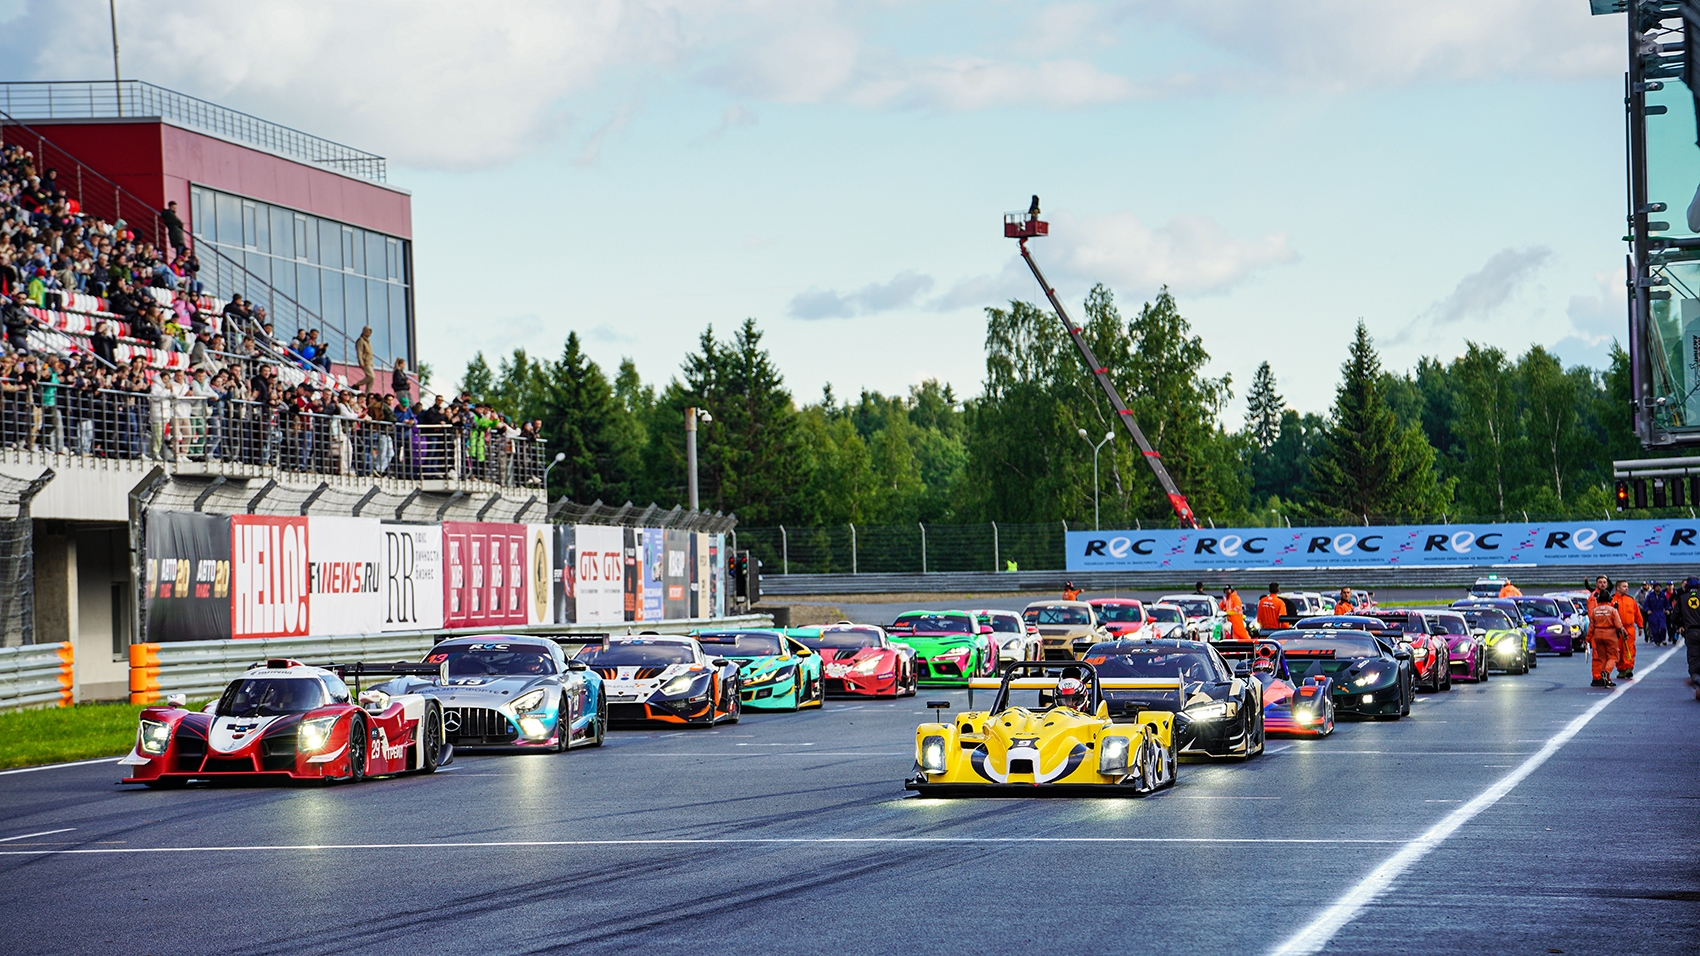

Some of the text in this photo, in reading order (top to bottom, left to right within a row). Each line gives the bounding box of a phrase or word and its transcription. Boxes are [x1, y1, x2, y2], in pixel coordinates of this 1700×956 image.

[1669, 528, 1700, 547] R
[196, 559, 217, 582] АВТО
[235, 524, 307, 634] HELLO!
[309, 562, 380, 595] F1NEWS.RU
[385, 532, 417, 623] RR
[580, 551, 598, 581] GTS
[603, 552, 621, 581] GTS
[427, 653, 448, 664] 13
[371, 739, 381, 760] 29
